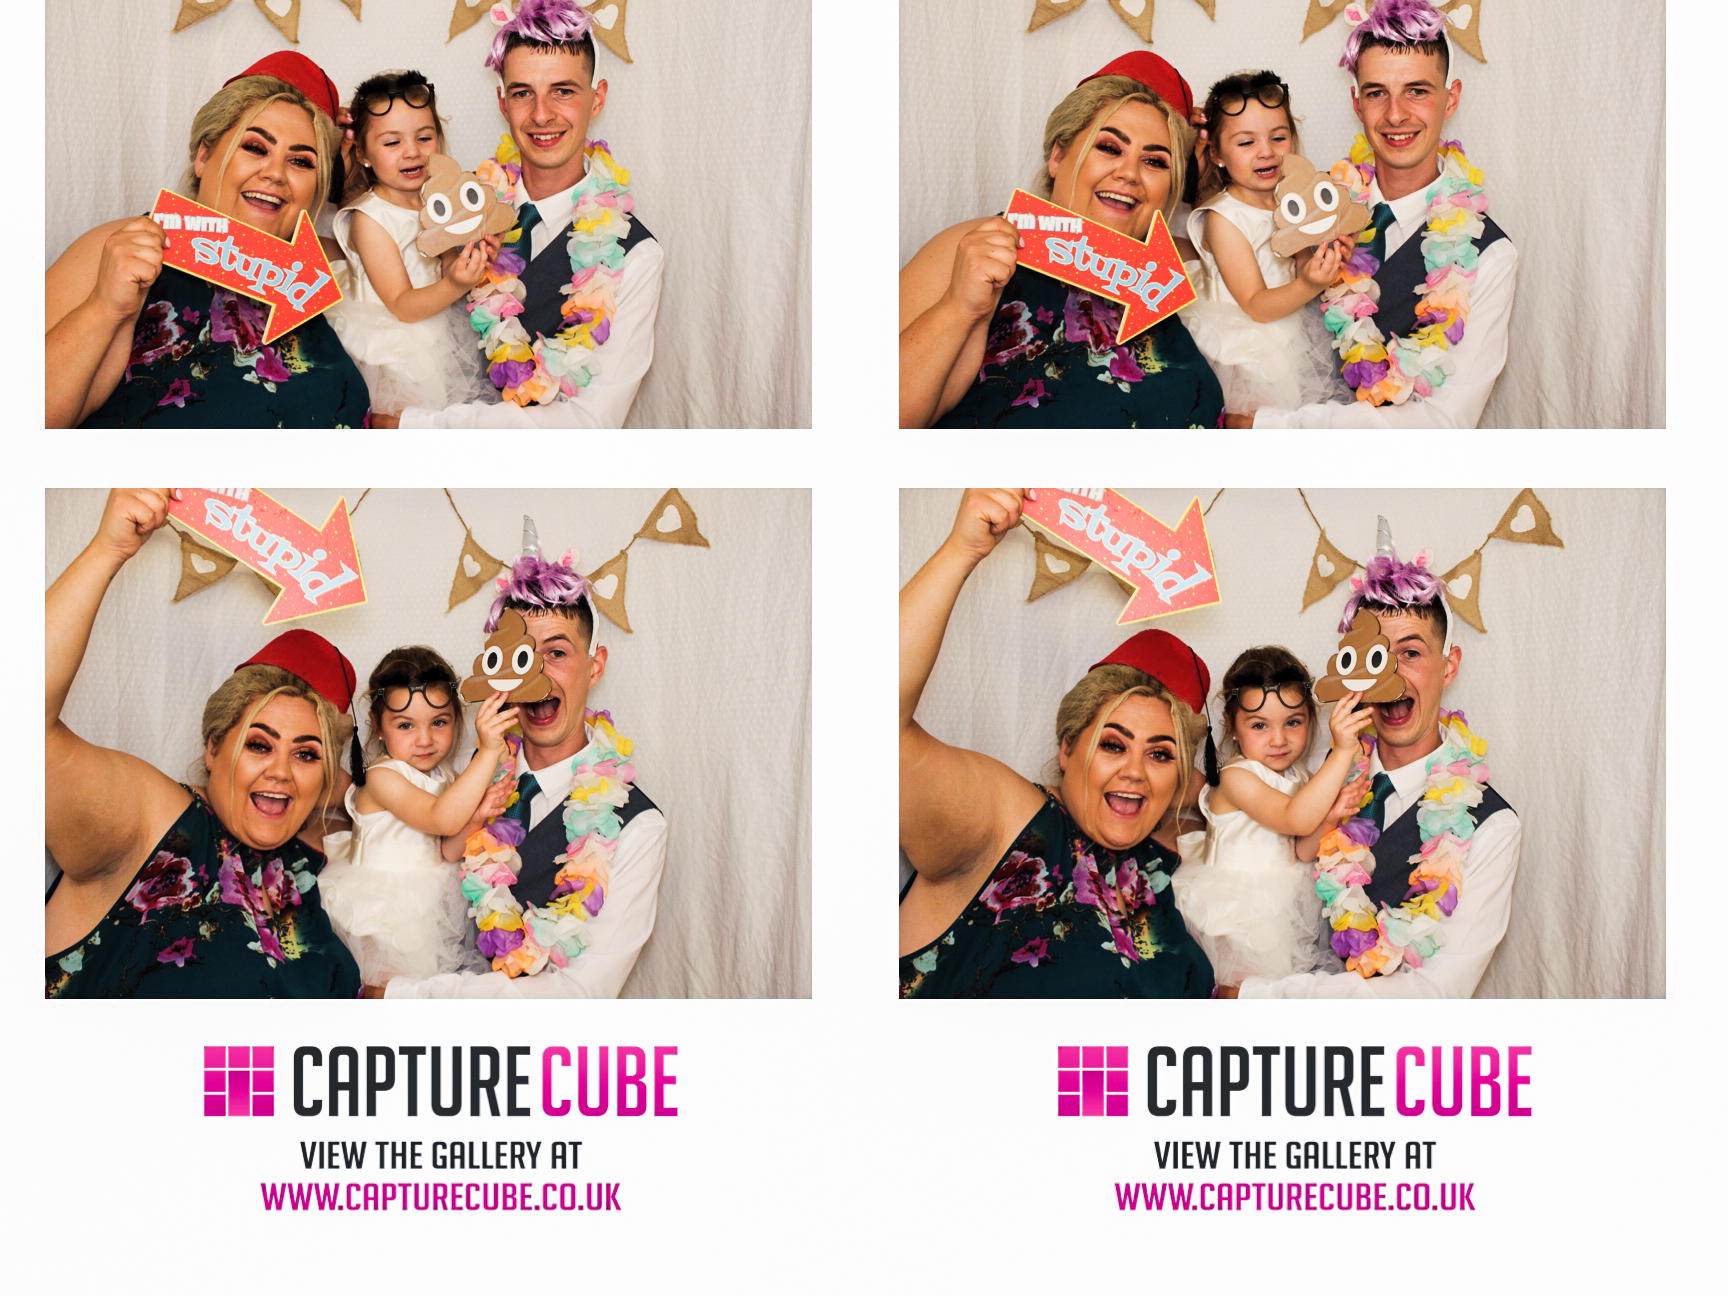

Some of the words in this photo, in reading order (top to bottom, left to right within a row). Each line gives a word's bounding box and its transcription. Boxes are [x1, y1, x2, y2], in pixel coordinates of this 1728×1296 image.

[184, 215, 229, 234] WITH
[1038, 215, 1083, 234] WITH
[191, 235, 332, 313] stupid
[1045, 235, 1186, 313] stupid
[203, 497, 360, 605] stupid
[1057, 497, 1214, 605] stupid
